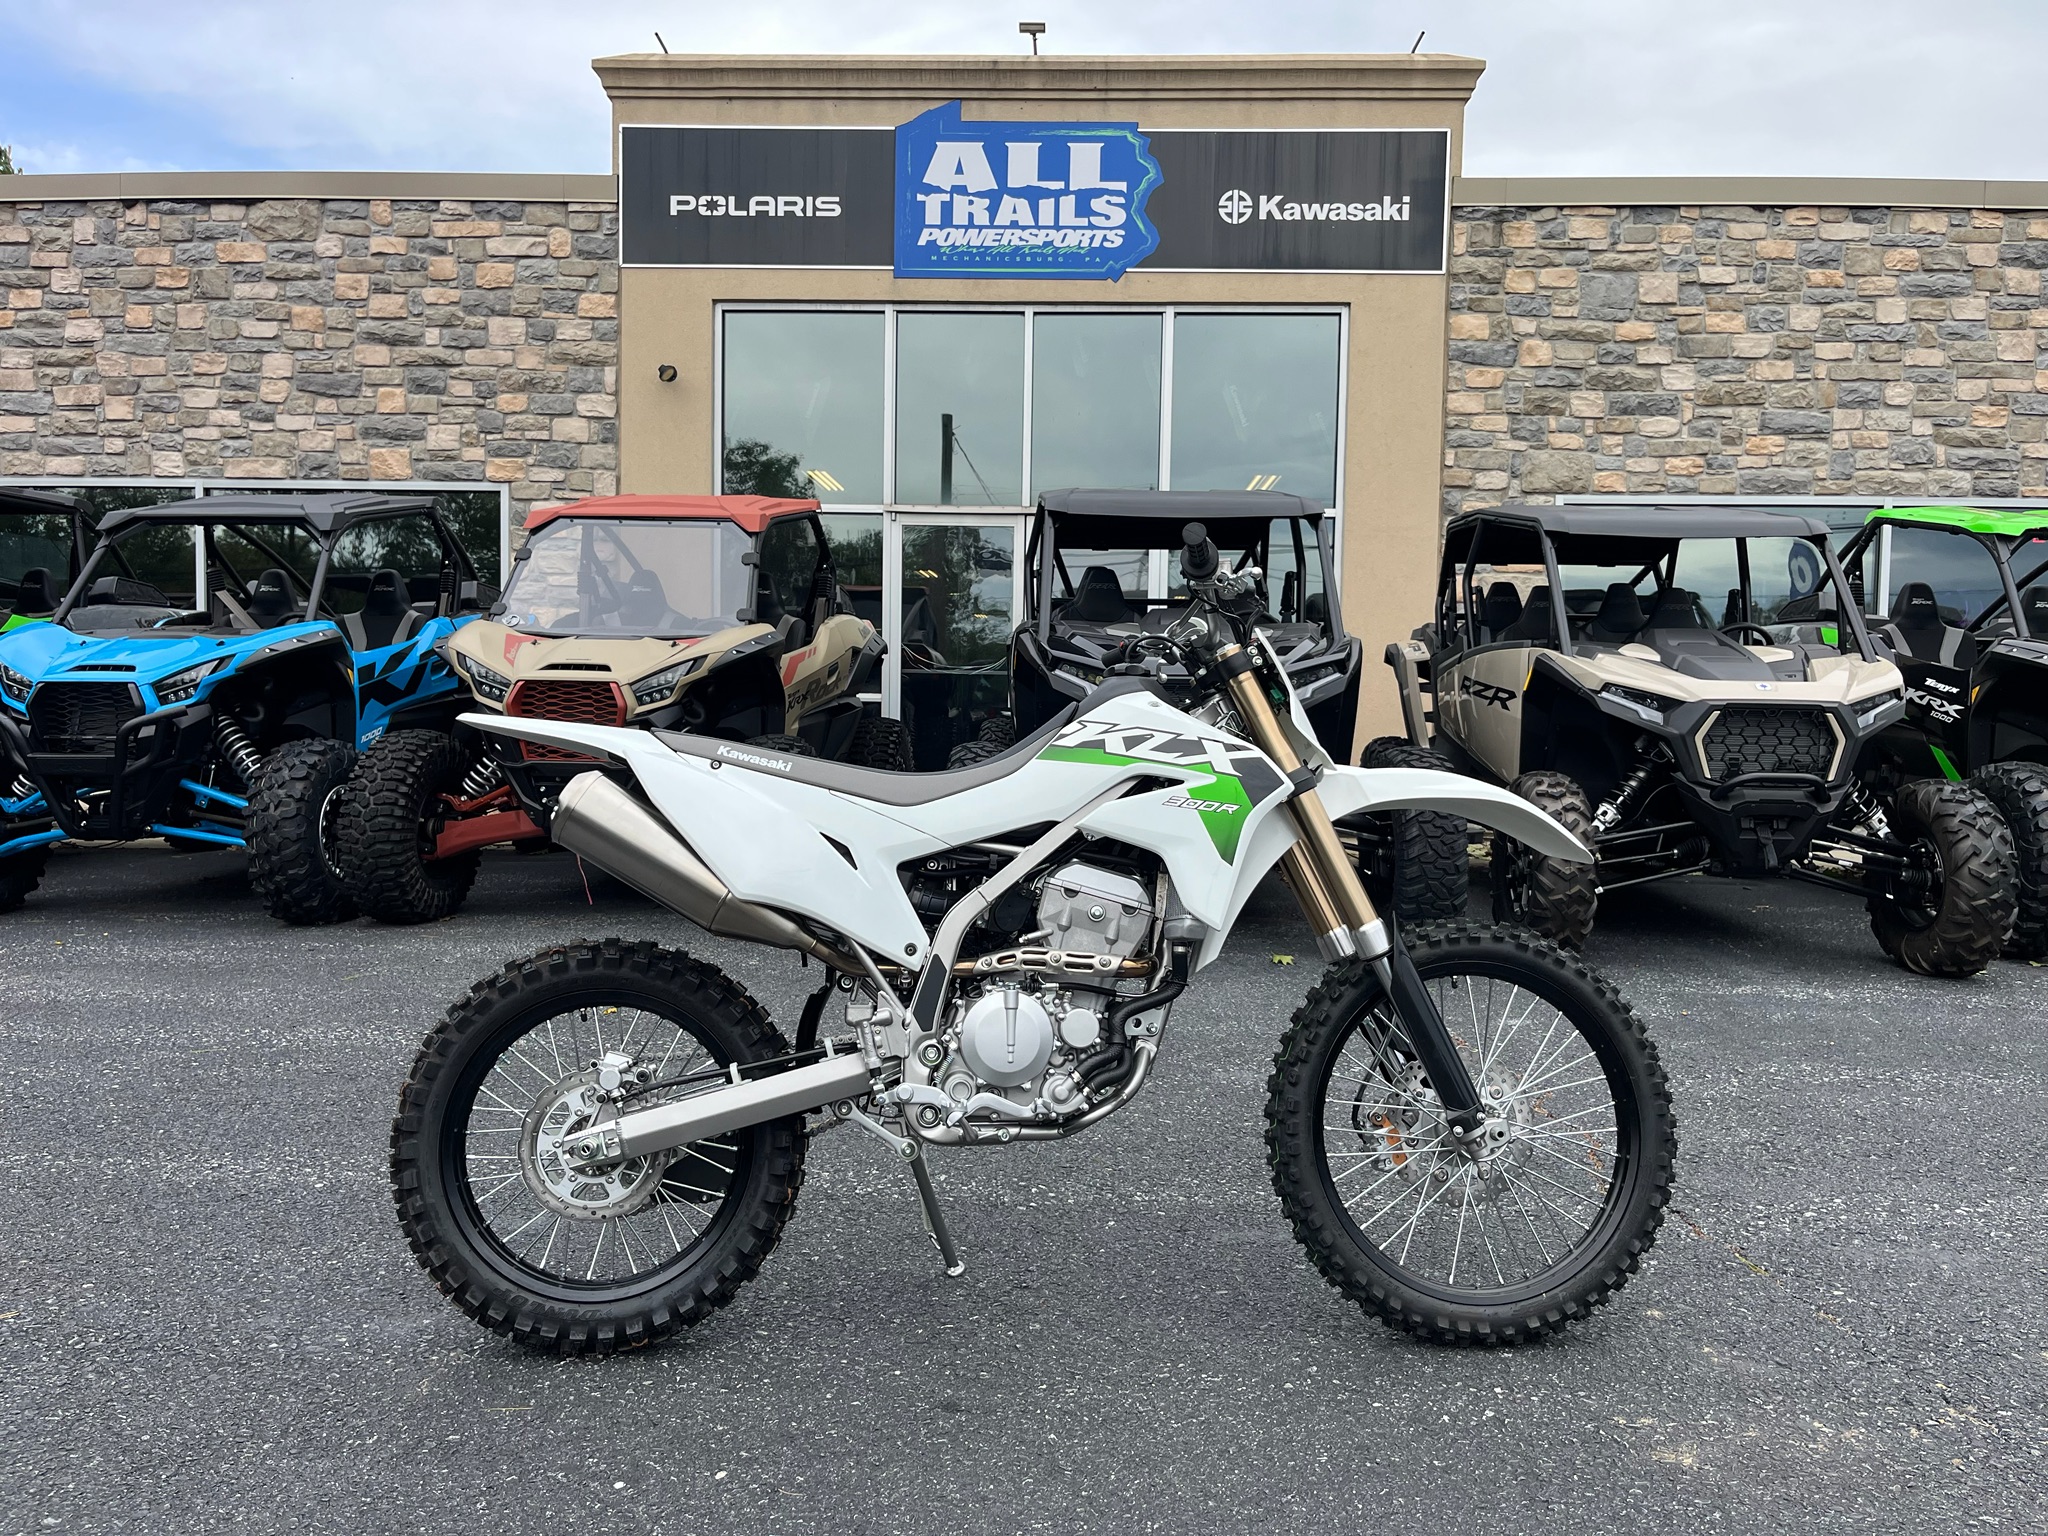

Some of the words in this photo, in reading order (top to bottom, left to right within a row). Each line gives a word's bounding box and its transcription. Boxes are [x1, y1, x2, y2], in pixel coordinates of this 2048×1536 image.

[922, 142, 1127, 193] ALL
[669, 195, 842, 217] POLARIS
[917, 193, 1127, 227] TRAILS
[1258, 195, 1411, 221] Kawasaki
[917, 228, 1126, 248] POWERSPORTS
[940, 245, 985, 254] Where
[987, 245, 1016, 255] All
[1018, 245, 1055, 254] Trails
[1460, 675, 1517, 711] RZR
[1924, 677, 1960, 694] Teryx
[1904, 686, 1965, 719] KRX
[1930, 710, 1954, 723] 1000
[361, 726, 383, 743] 1000
[716, 745, 793, 772] Kawasaki
[1051, 720, 1258, 777] KLX
[1161, 795, 1242, 815] 300R
